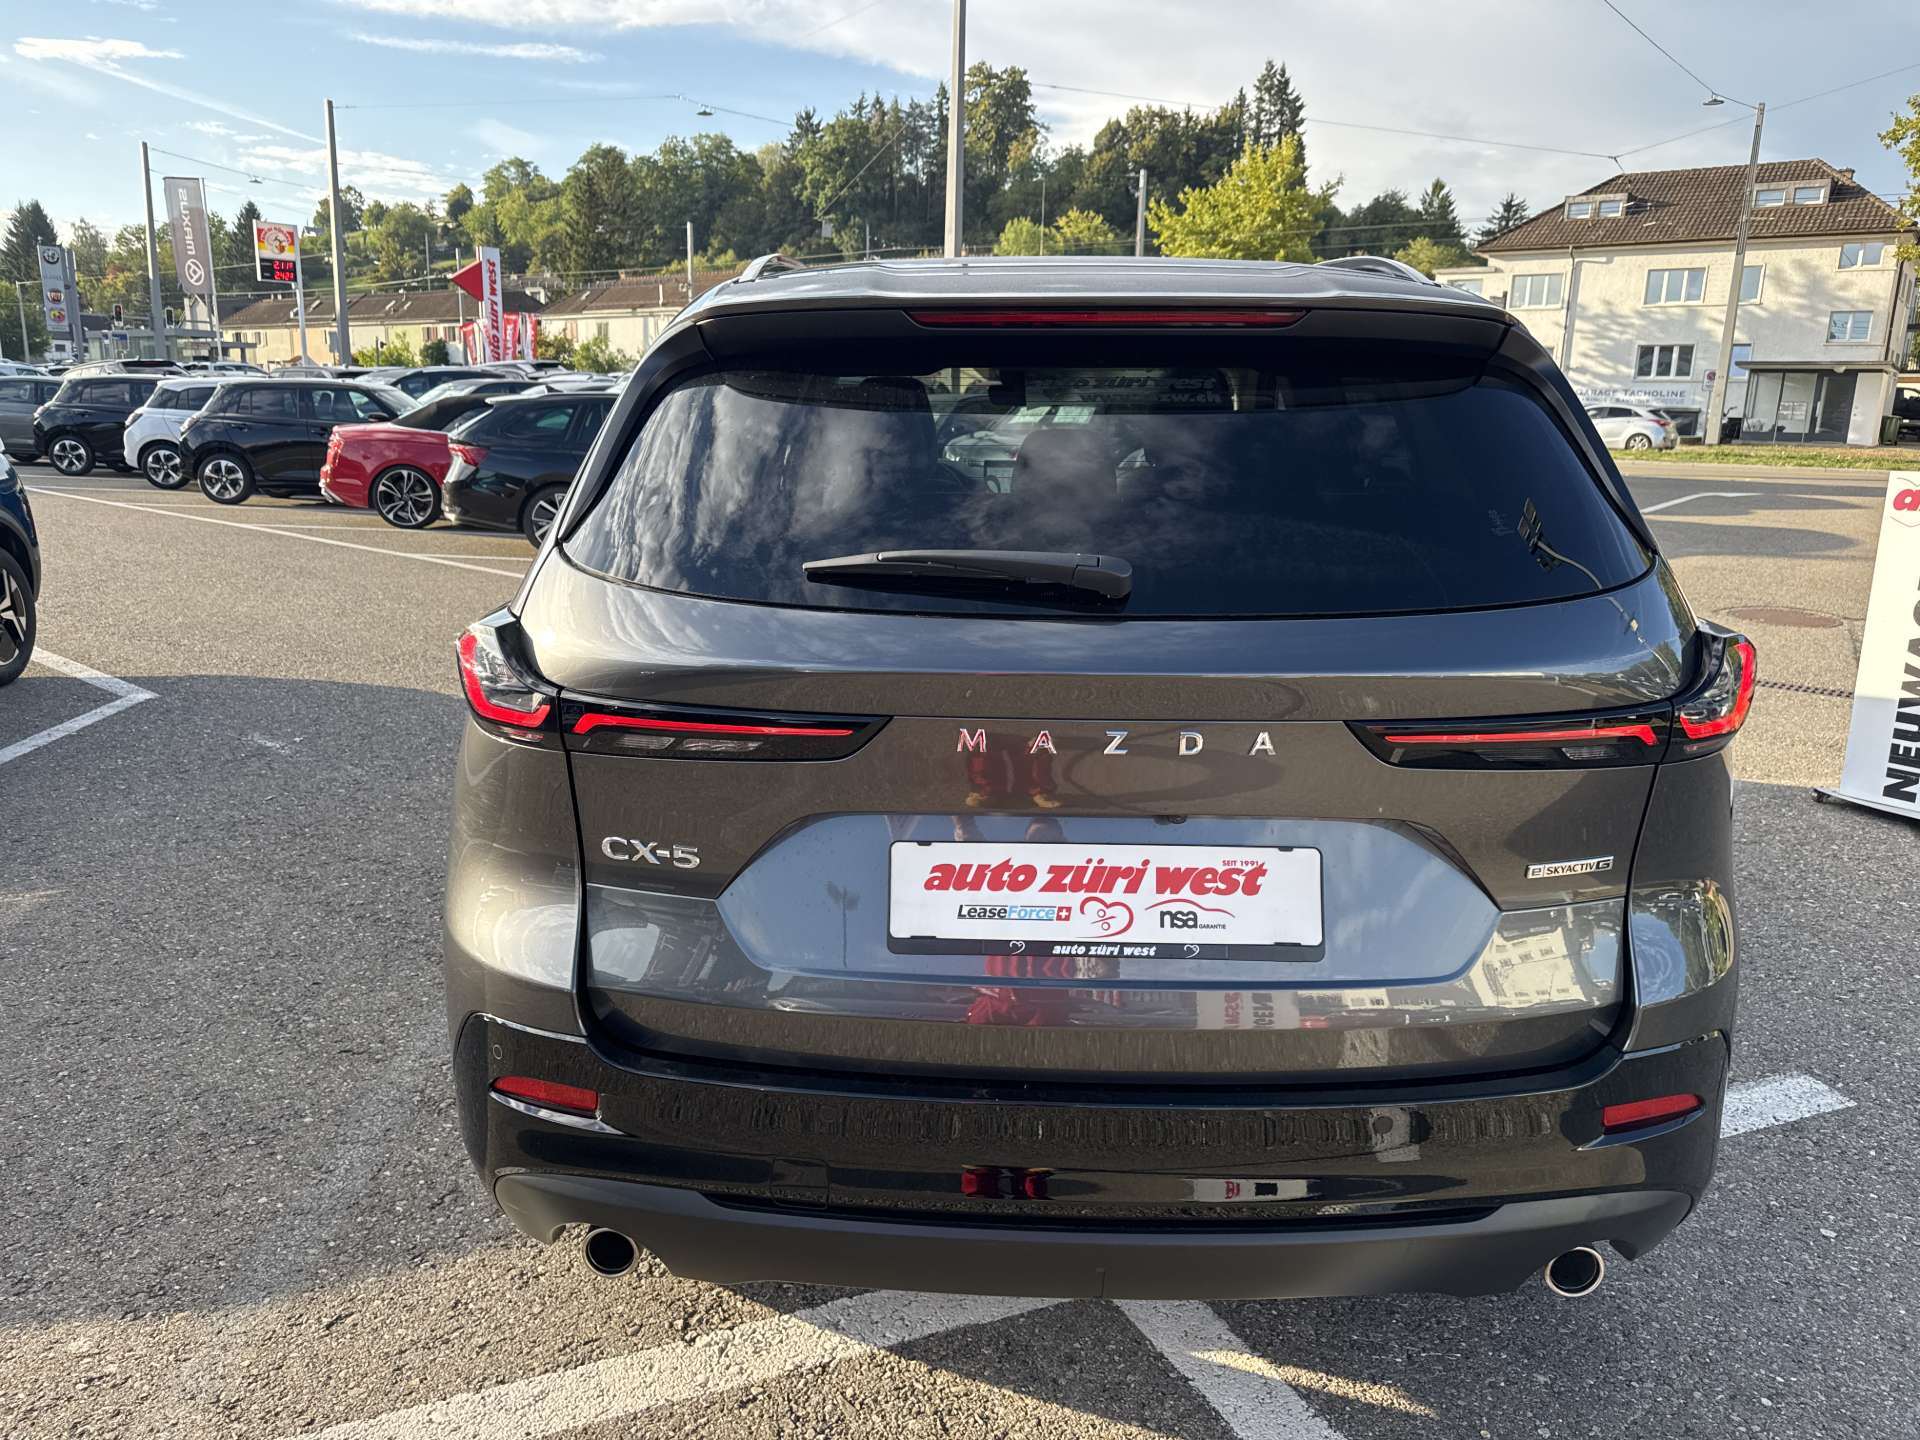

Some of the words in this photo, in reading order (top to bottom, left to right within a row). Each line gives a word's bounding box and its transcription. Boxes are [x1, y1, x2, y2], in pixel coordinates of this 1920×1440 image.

[487, 259, 497, 296] west
[1621, 388, 1687, 398] TACHOLINE
[956, 728, 1276, 756] MAZDA
[601, 836, 701, 869] CX-5
[1222, 859, 1237, 867] SEIT
[924, 857, 1037, 893] auto
[1040, 858, 1151, 894] züri
[1155, 862, 1268, 896] west
[957, 904, 1056, 920] LeaseForce
[1159, 909, 1198, 929] nsa
[1052, 945, 1085, 956] auto
[1089, 944, 1120, 956] züri
[1123, 945, 1157, 957] west
